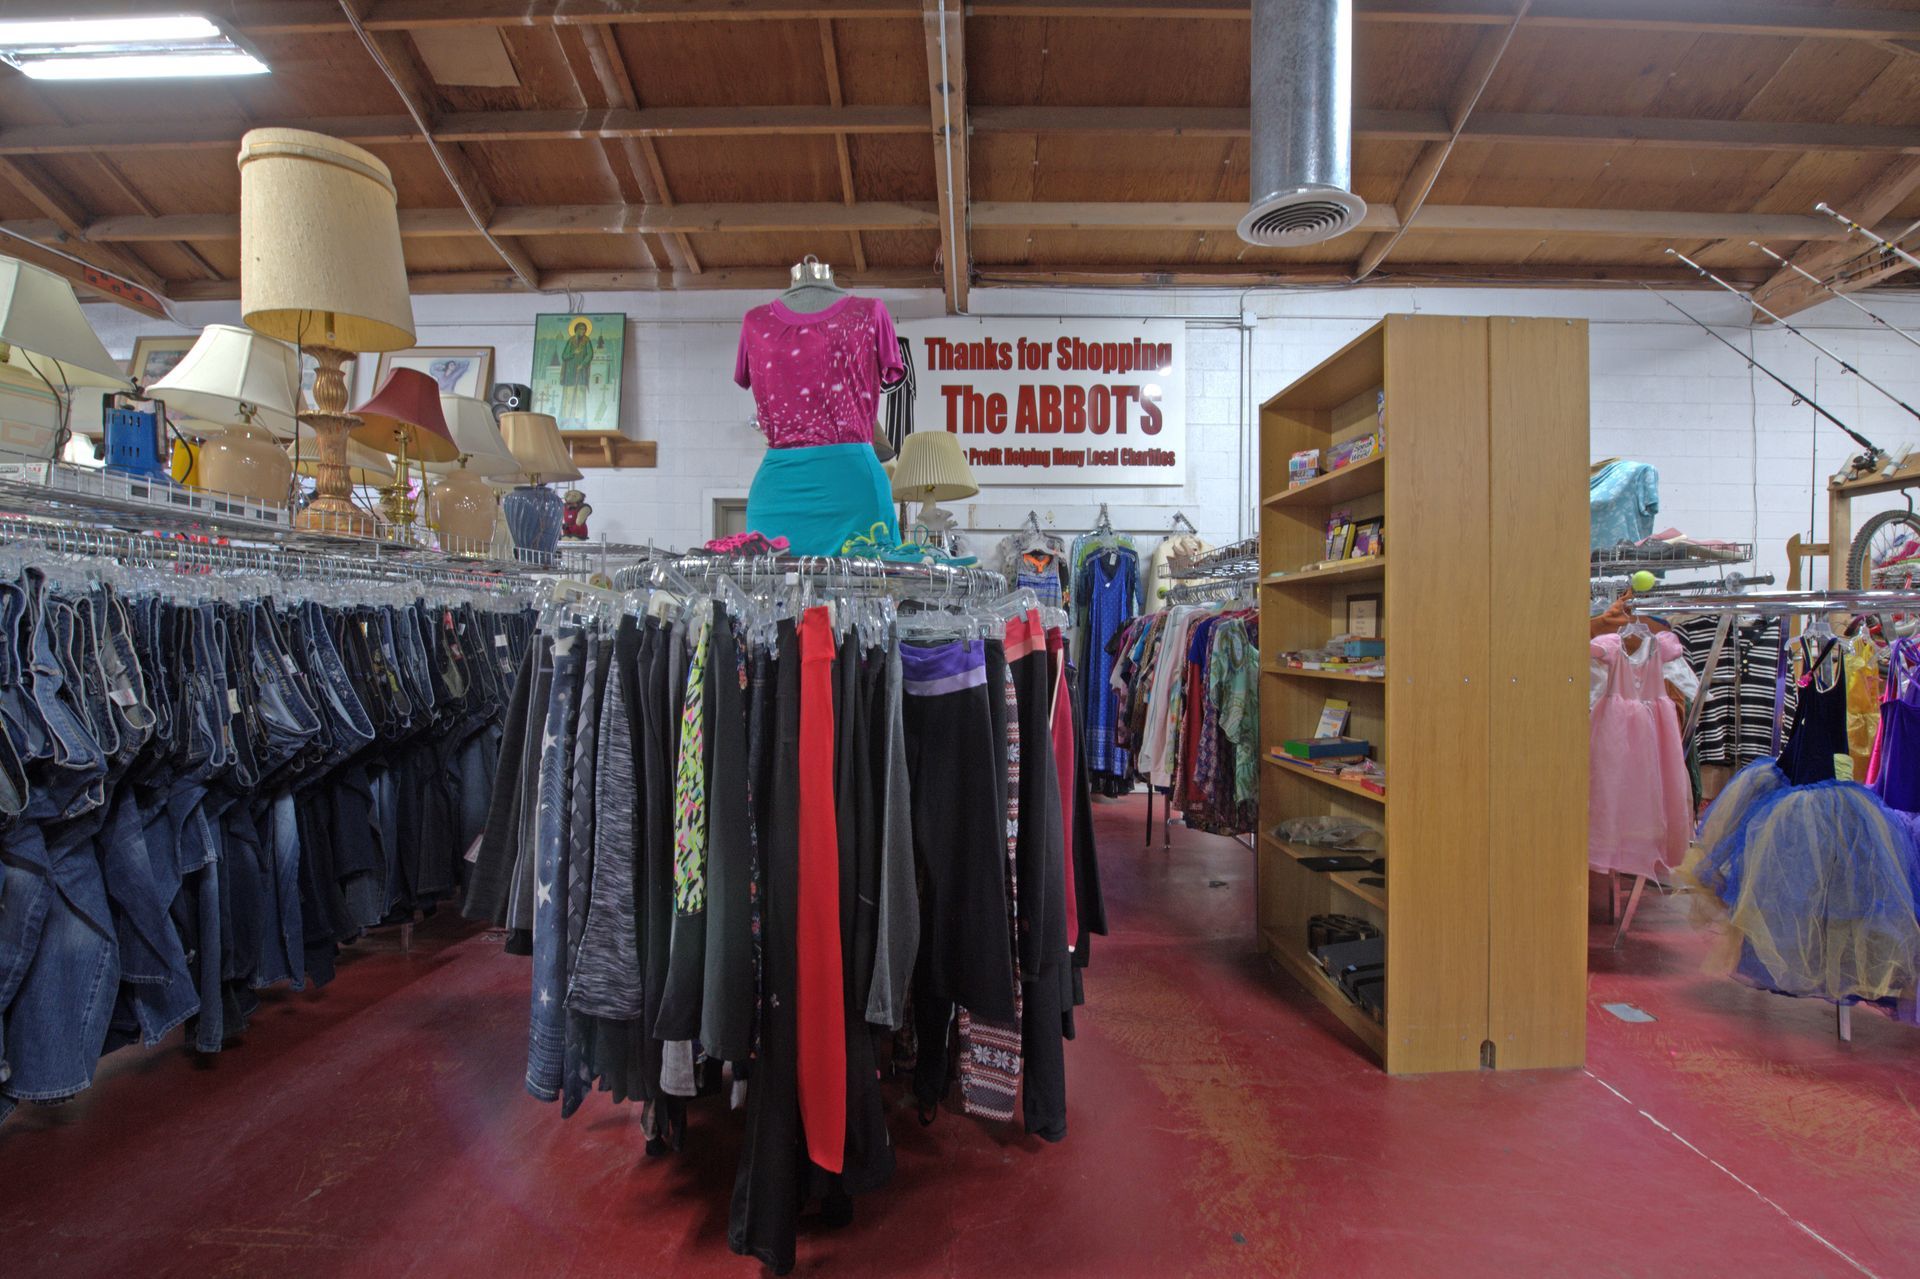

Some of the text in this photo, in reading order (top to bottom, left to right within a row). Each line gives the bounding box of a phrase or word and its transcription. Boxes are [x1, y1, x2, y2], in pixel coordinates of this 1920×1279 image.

[924, 336, 1173, 375] Thanks for Shopping
[941, 384, 1163, 435] The ABBOT'S
[969, 447, 1003, 466] Profit
[1004, 447, 1051, 468] Helping
[1052, 447, 1085, 468] Many
[1086, 447, 1119, 466] Local
[1120, 447, 1176, 467] Charities
